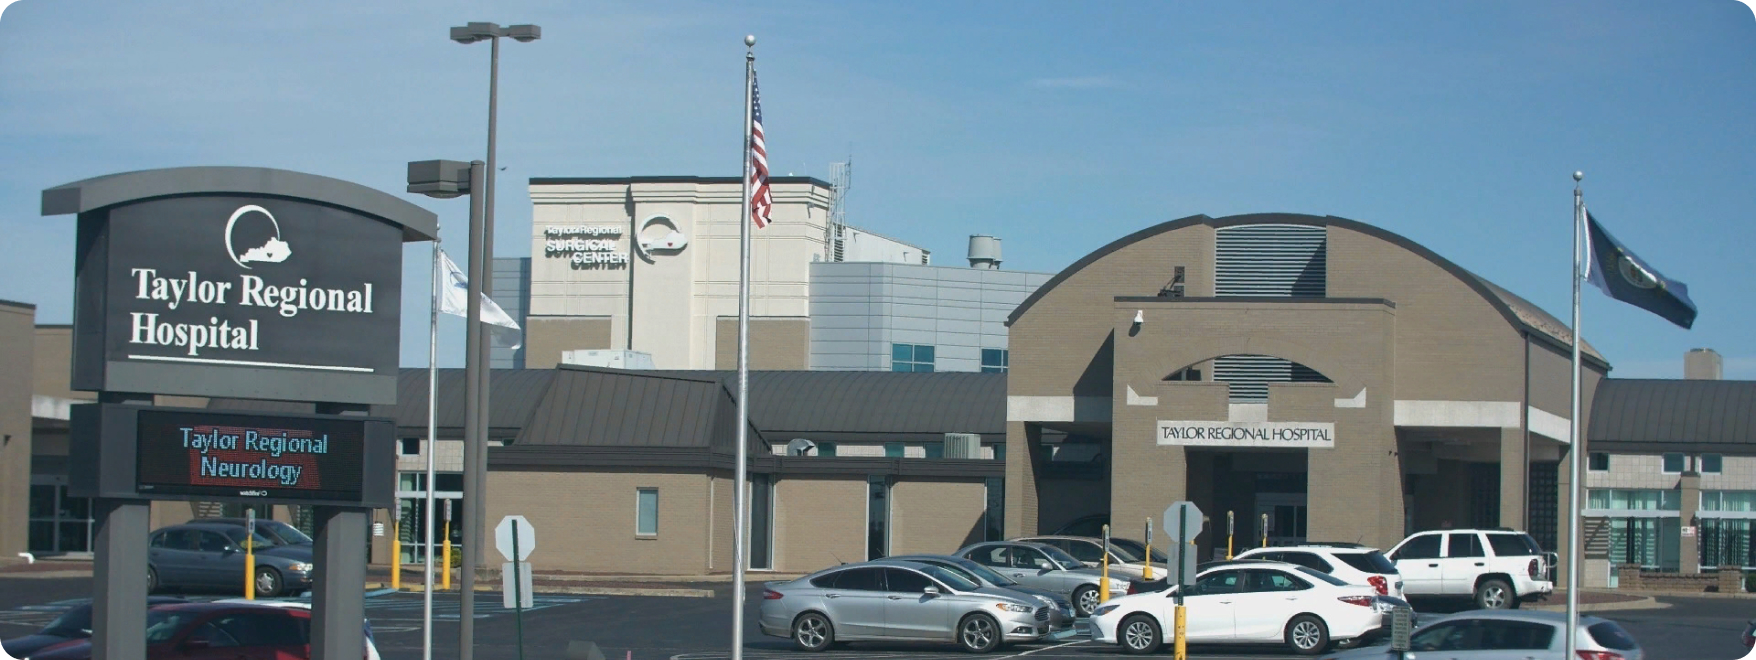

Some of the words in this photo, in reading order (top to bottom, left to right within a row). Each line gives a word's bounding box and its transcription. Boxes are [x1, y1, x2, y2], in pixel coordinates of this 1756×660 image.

[546, 225, 578, 236] Taylor
[580, 226, 622, 236] Regional
[546, 239, 617, 251] SURGICAL
[572, 252, 629, 264] CENTER
[131, 268, 231, 310] Taylor
[239, 274, 373, 316] Regional
[129, 312, 259, 356] Hospital
[180, 427, 239, 453] Taylor
[245, 430, 328, 457] Regional
[1161, 426, 1205, 440] TAYLOR
[1207, 427, 1270, 441] REGIONAL
[1272, 428, 1332, 441] HOSPITAL
[201, 456, 302, 485] Neurology
